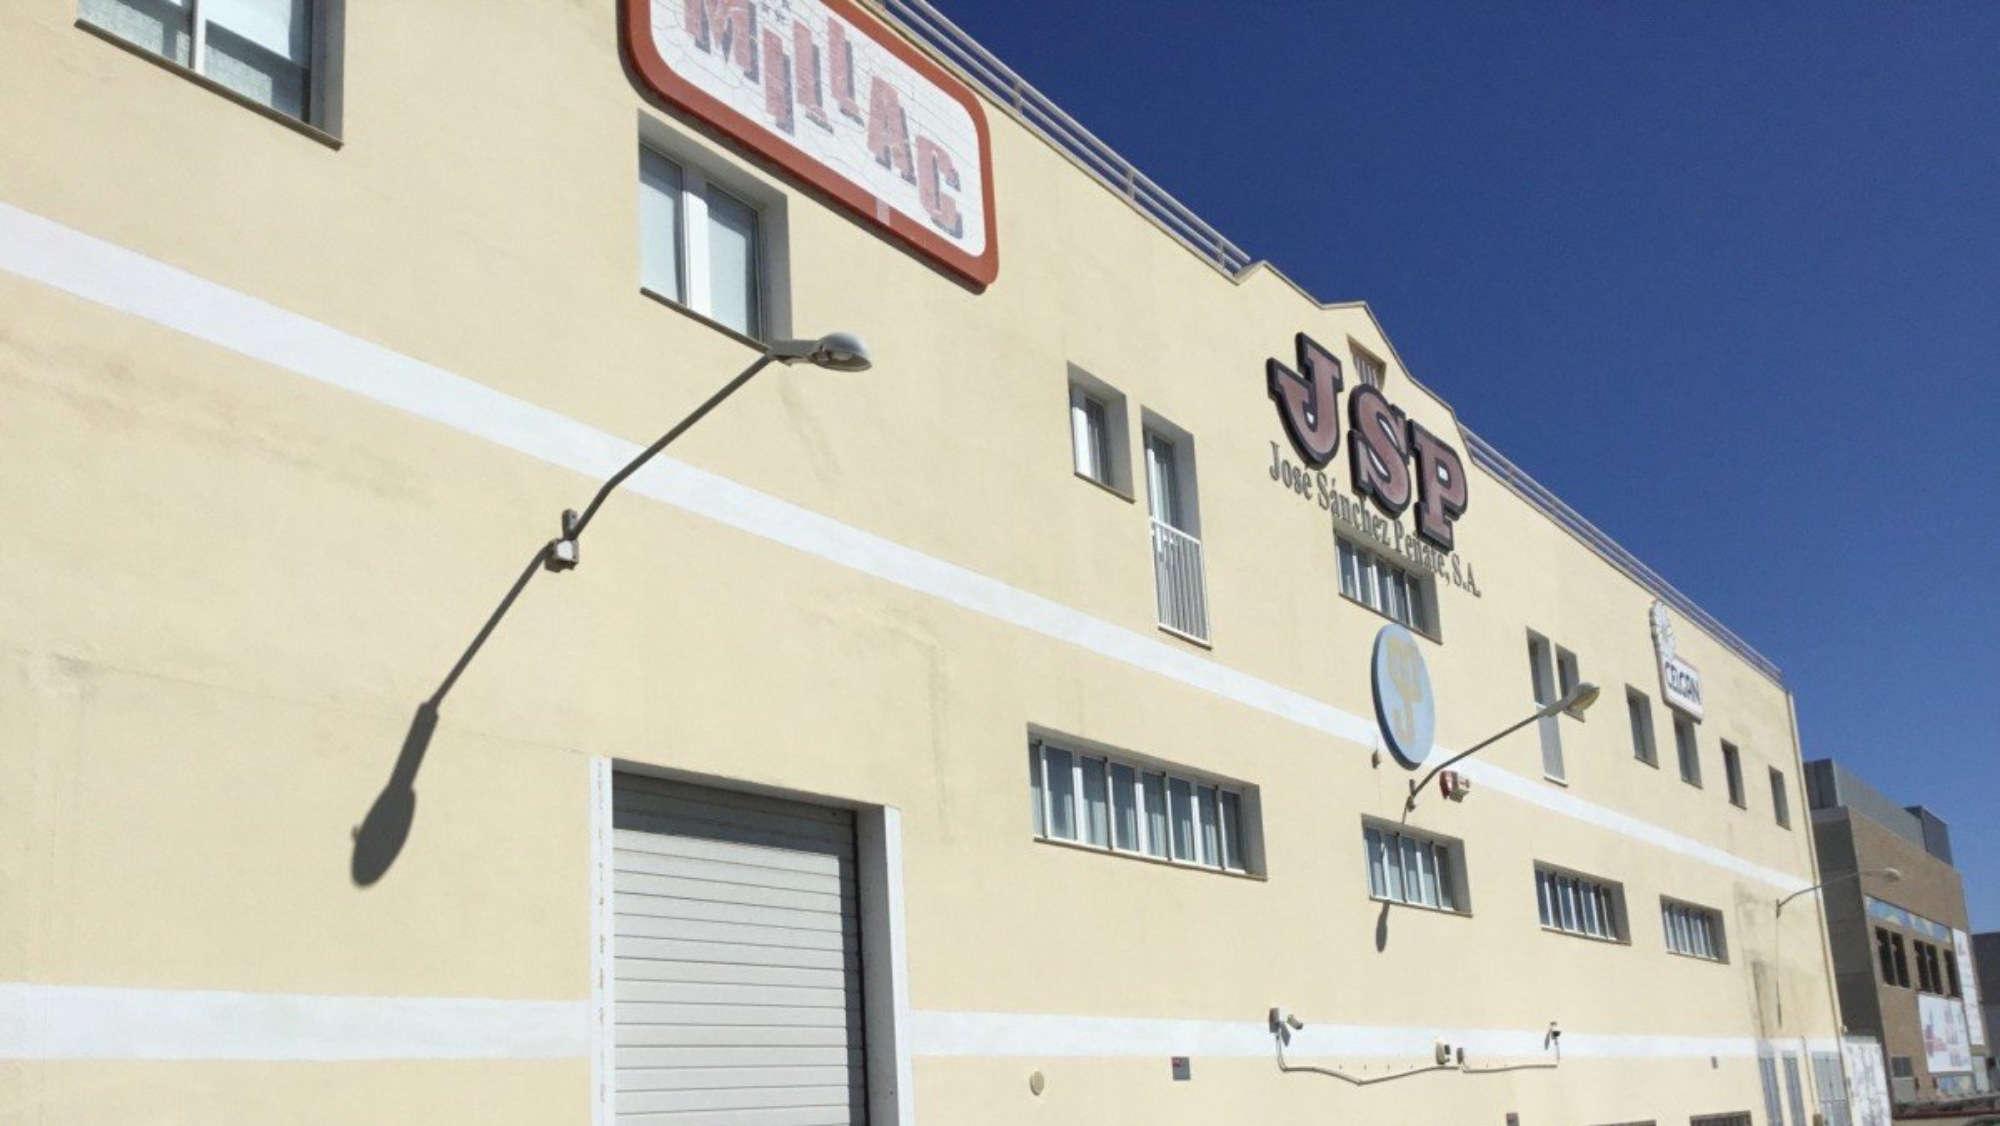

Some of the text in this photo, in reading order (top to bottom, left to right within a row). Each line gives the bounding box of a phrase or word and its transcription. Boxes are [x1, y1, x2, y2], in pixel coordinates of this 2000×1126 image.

[684, 0, 964, 240] MILLAC
[1266, 331, 1468, 554] JSP
[1269, 440, 1313, 501] José
[1317, 471, 1390, 546] Sánchez
[1451, 553, 1482, 598] S.A.
